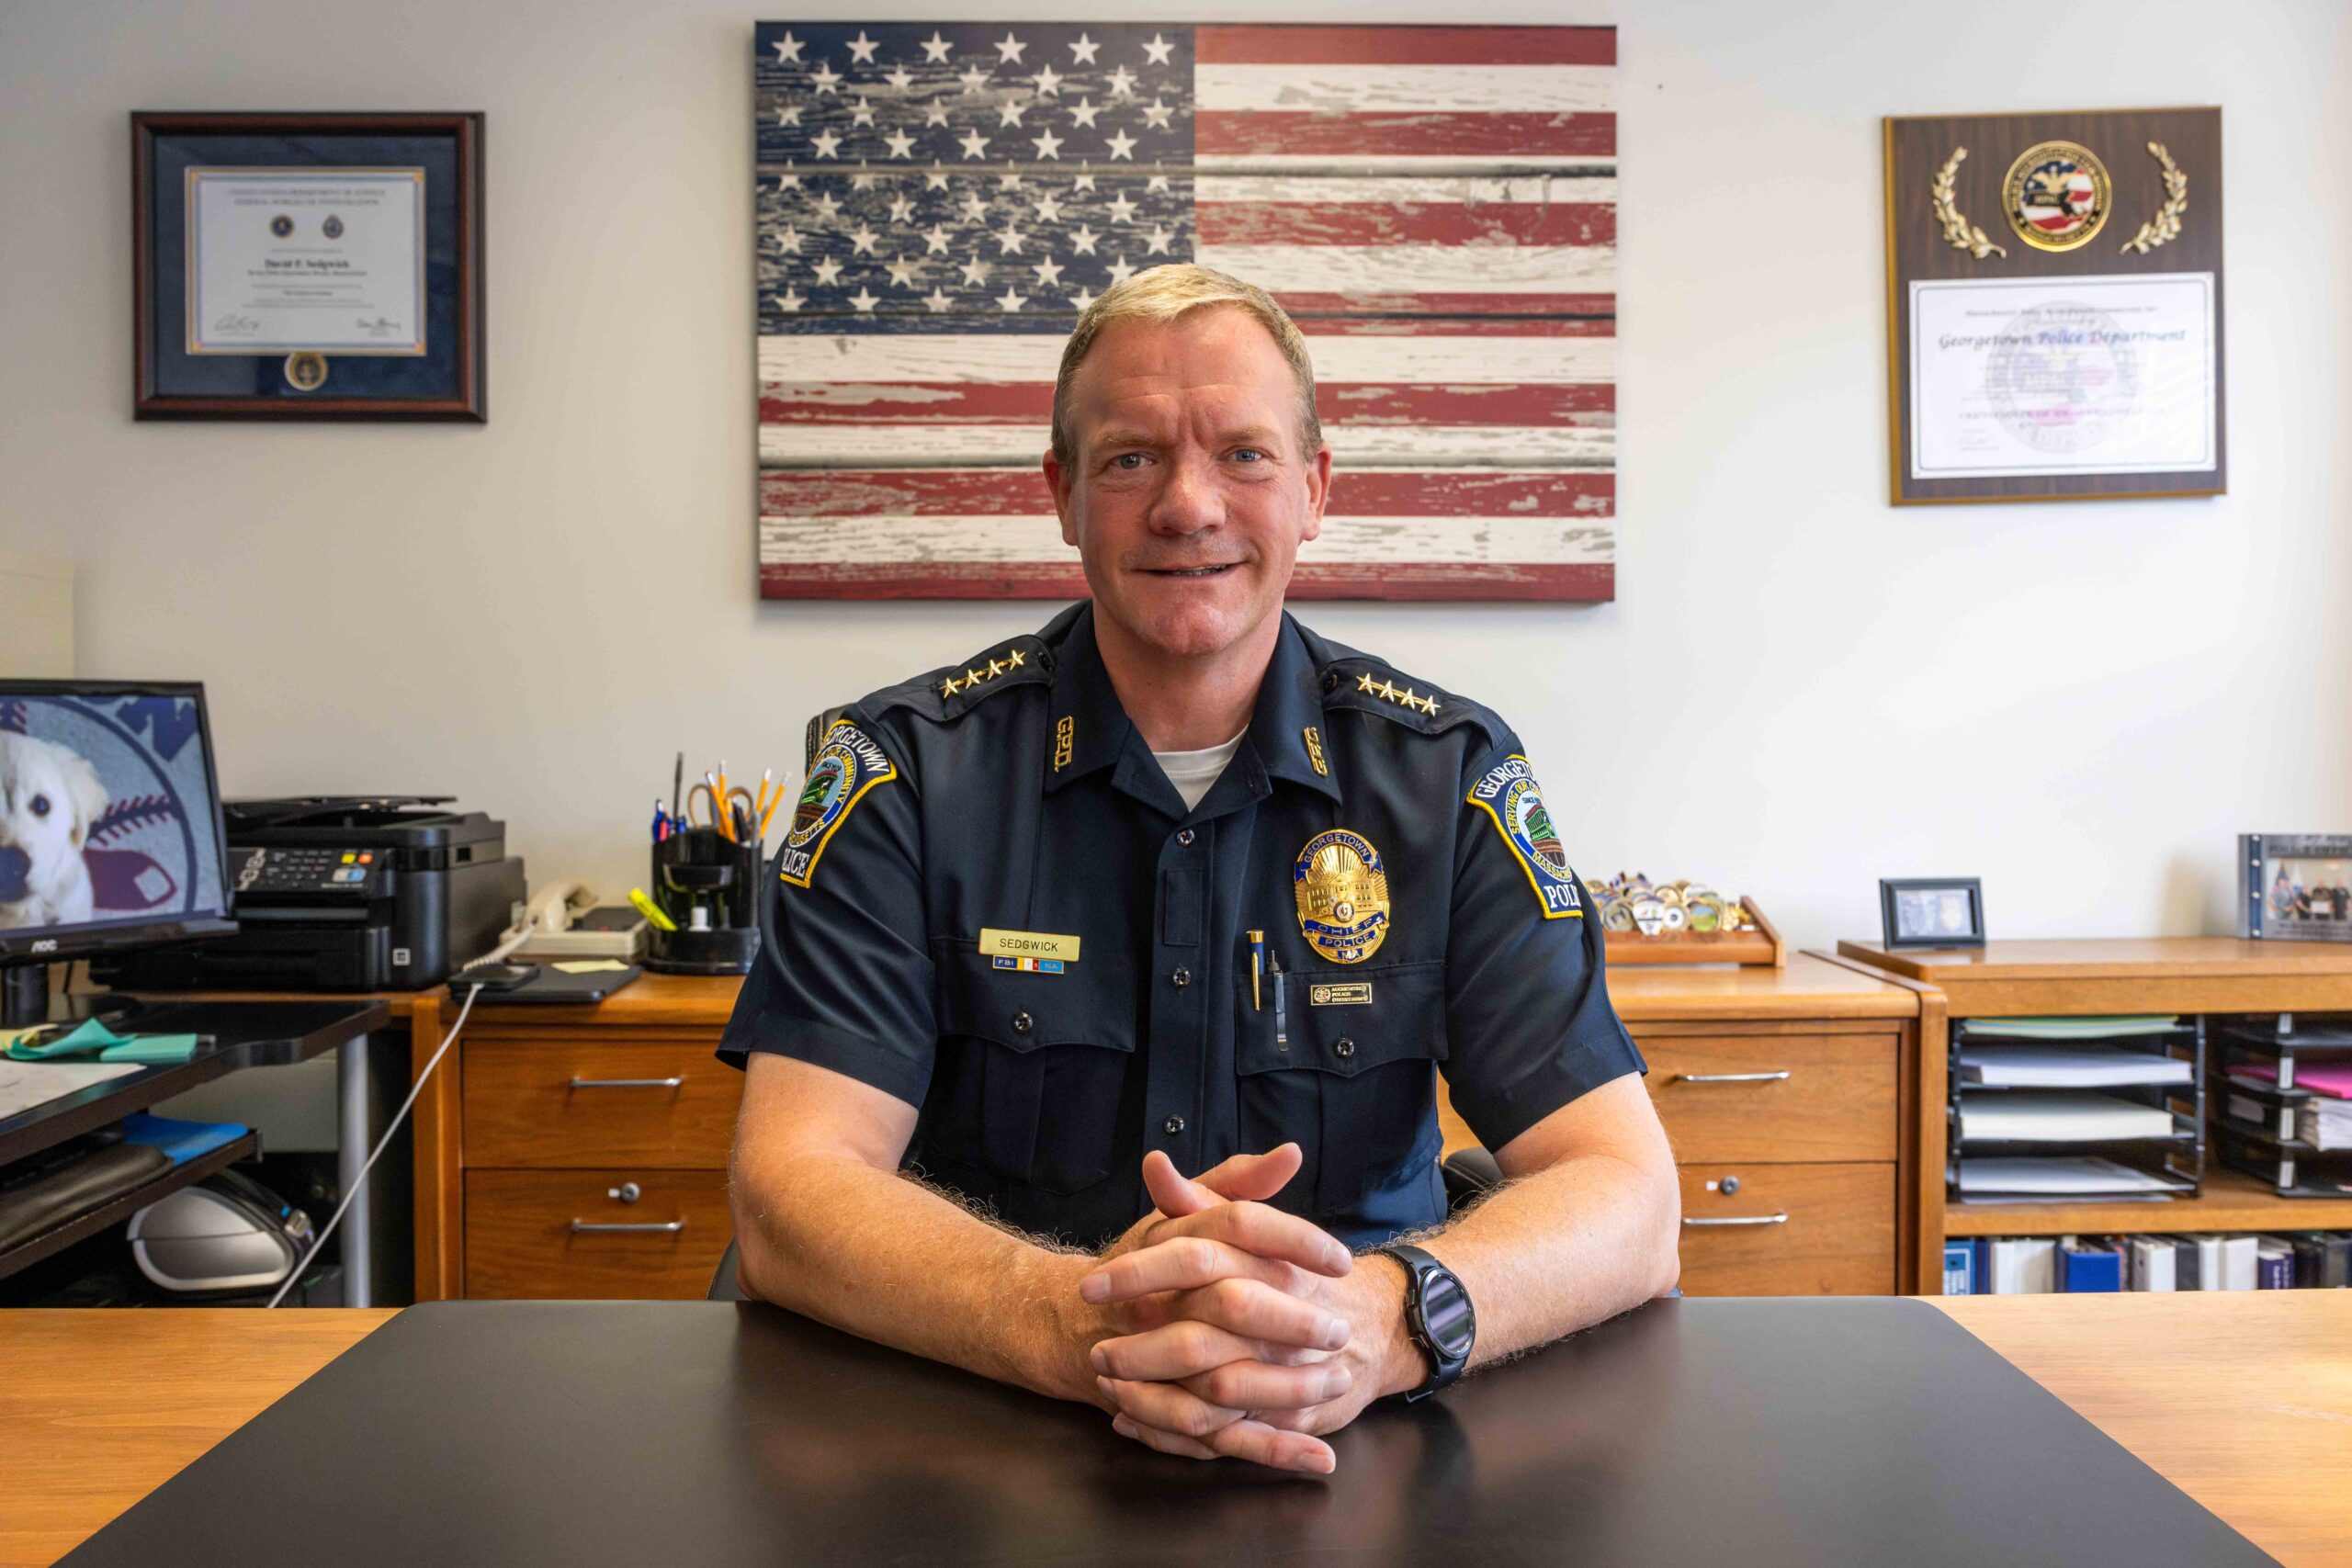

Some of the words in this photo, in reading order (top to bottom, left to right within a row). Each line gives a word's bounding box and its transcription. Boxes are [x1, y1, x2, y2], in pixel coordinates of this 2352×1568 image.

[1939, 333, 2033, 351] Georgetown
[2037, 331, 2084, 345] Police
[2087, 329, 2186, 345] Department
[1507, 789, 1520, 835] SERVING
[1304, 833, 1370, 863] GEORGETOWN
[782, 848, 810, 877] LICE
[1544, 885, 1581, 908] POLI
[1317, 919, 1374, 936] CHIEF
[1000, 938, 1058, 952] SEDGWICK
[1324, 933, 1371, 947] POLICE
[1341, 950, 1360, 959] MA
